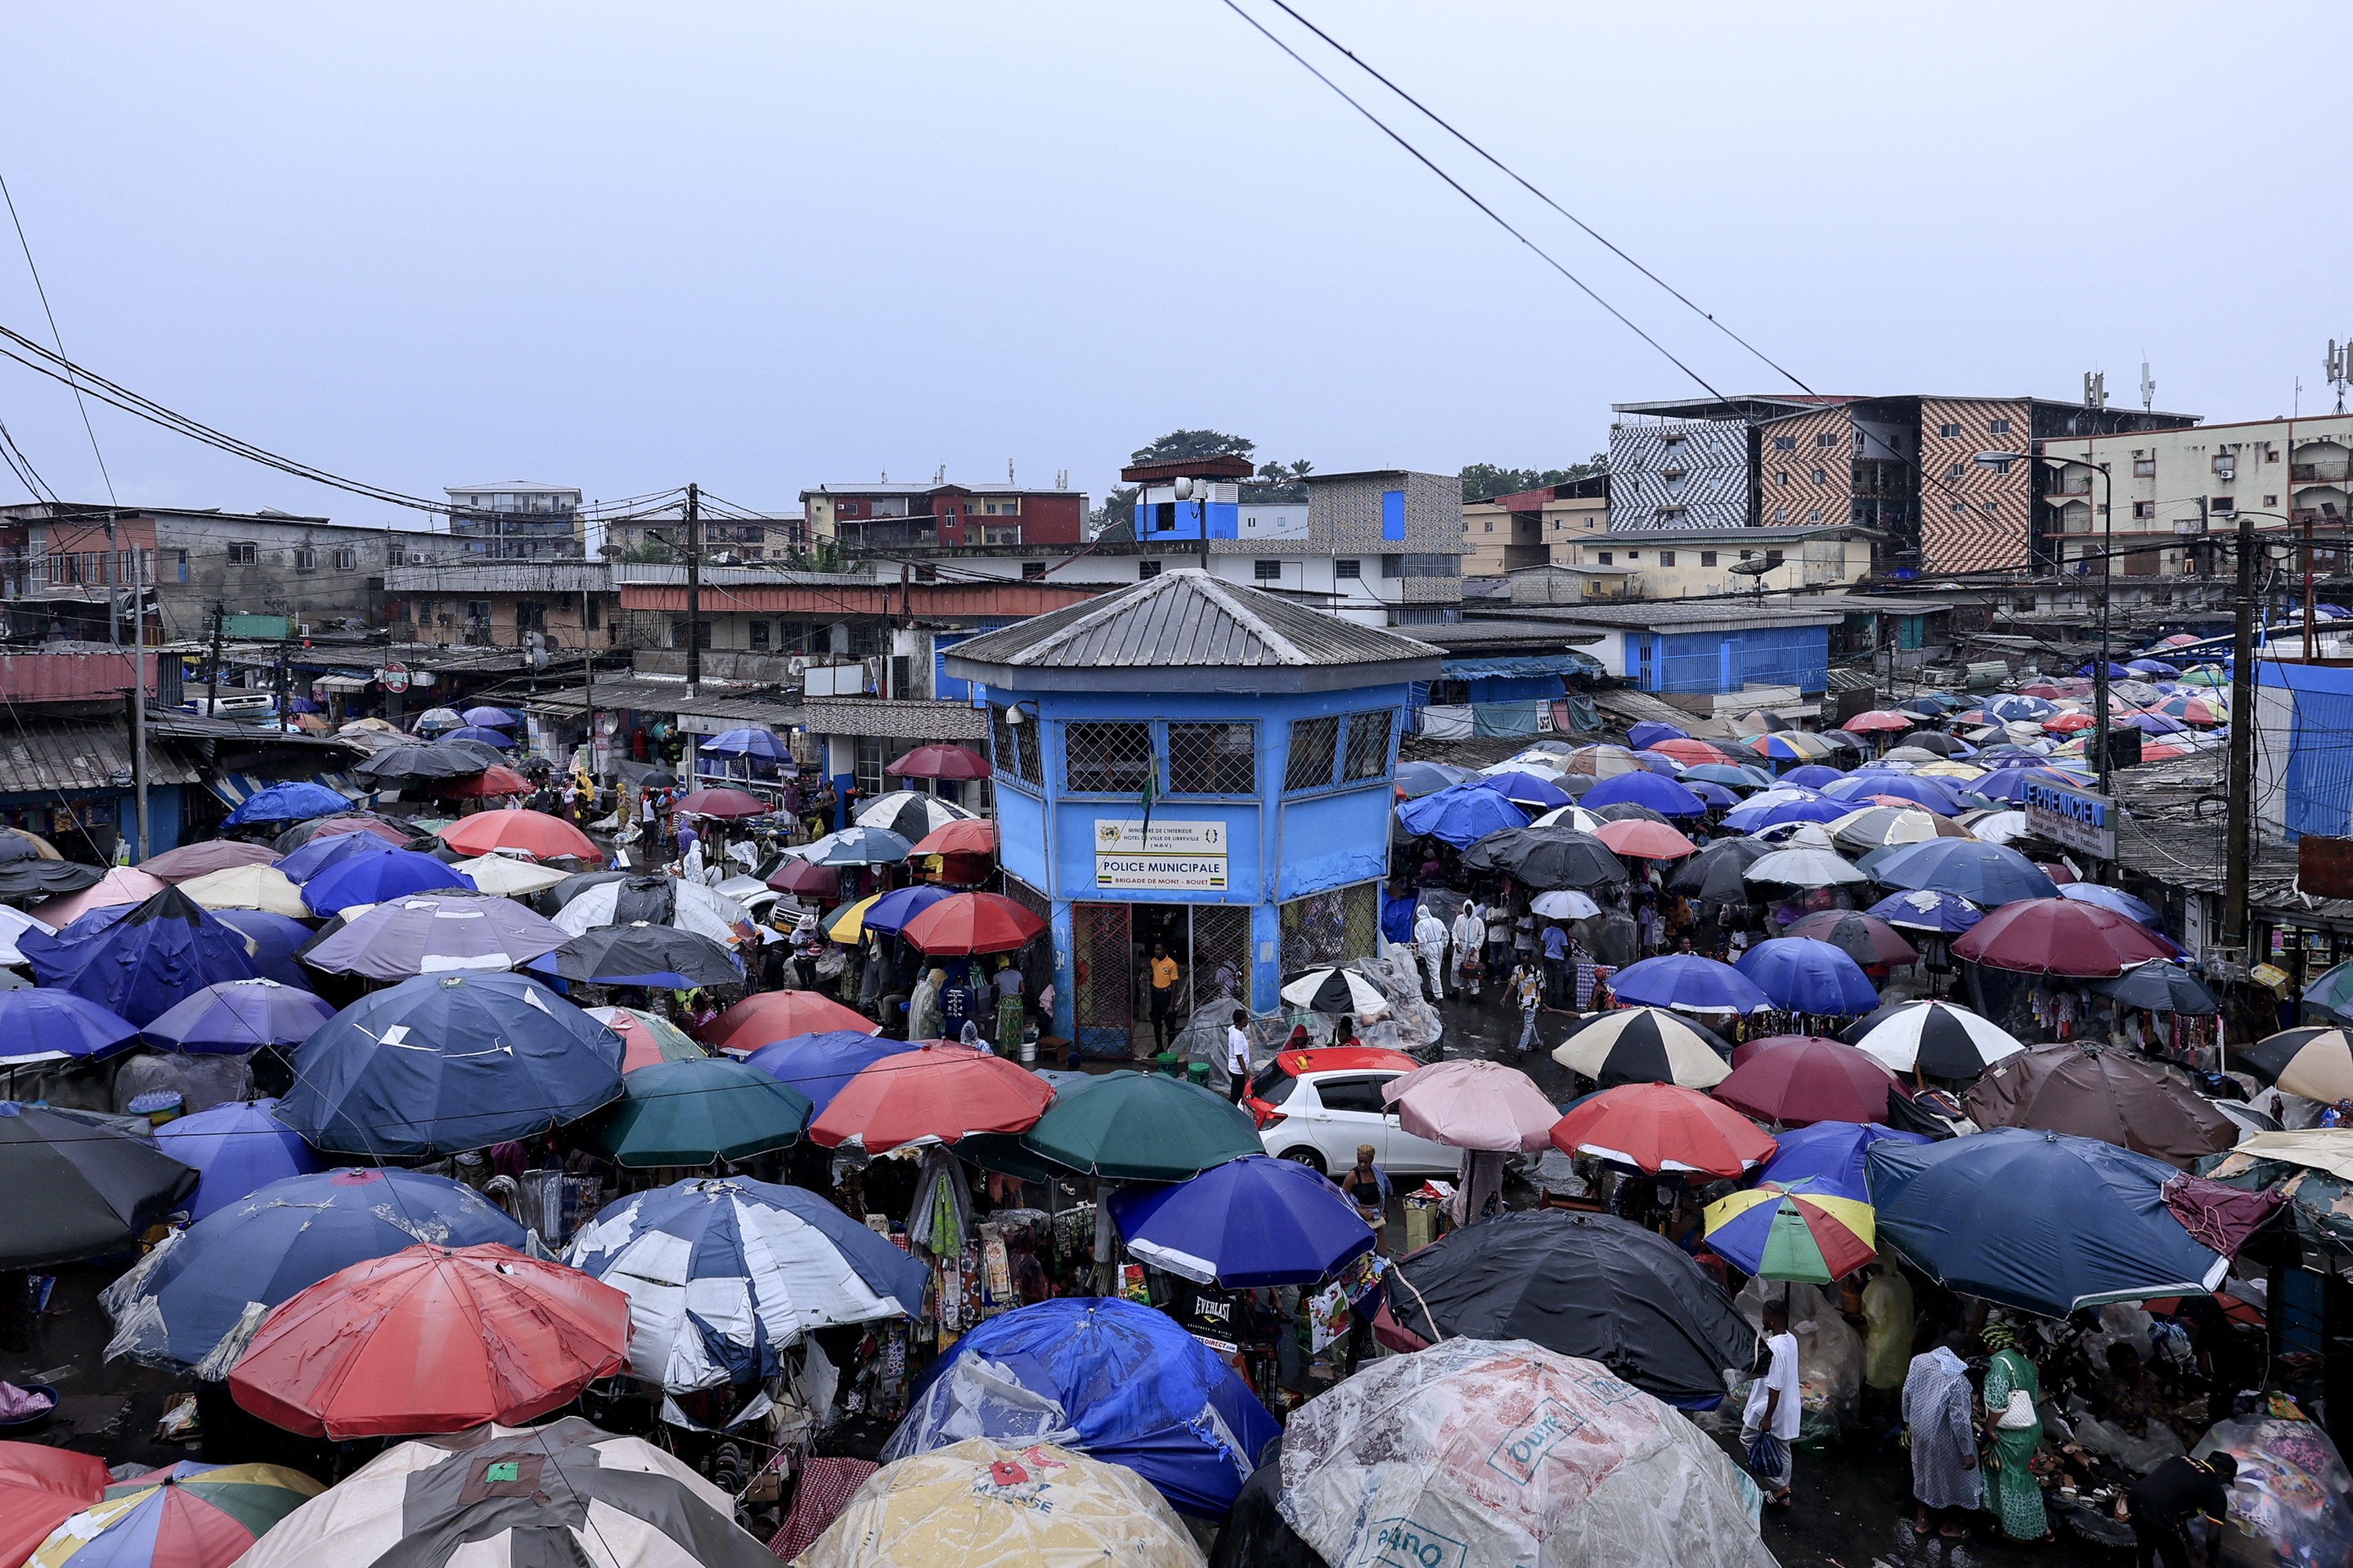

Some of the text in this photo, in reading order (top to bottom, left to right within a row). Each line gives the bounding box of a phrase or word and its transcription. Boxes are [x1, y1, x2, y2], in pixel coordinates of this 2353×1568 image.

[1104, 862, 1220, 873] POLICE MUNICIPALE
[1194, 1295, 1231, 1323] EVERLAST
